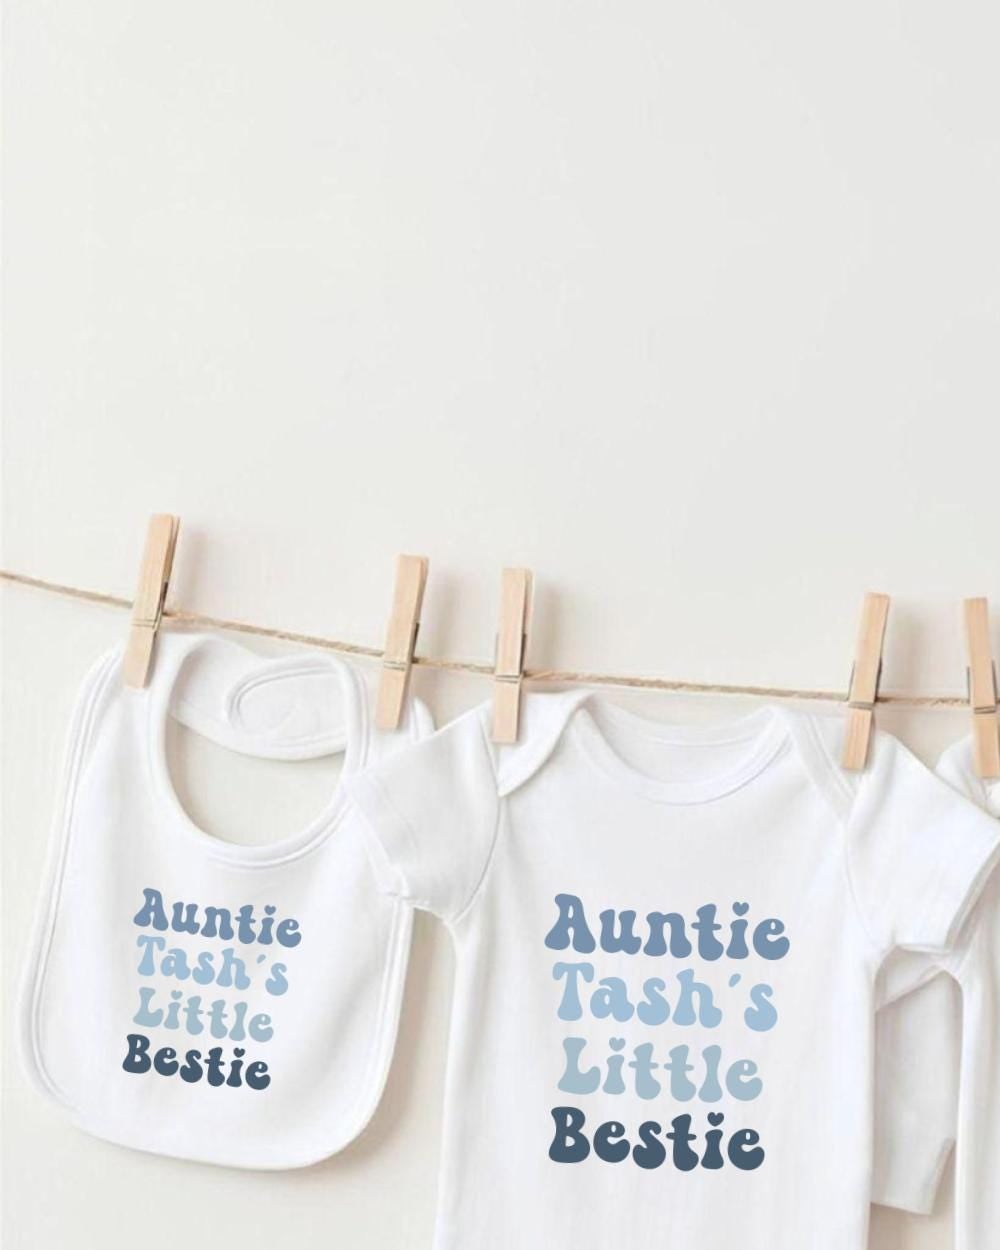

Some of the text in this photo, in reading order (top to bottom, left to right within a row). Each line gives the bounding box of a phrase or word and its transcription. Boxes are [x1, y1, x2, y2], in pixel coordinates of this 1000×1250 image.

[131, 886, 304, 951] Auntie
[543, 891, 793, 963] Auntie
[133, 986, 274, 1043] Little
[120, 1034, 273, 1093] Bestie
[556, 1035, 765, 1105] Little
[547, 1106, 767, 1174] Bestie
